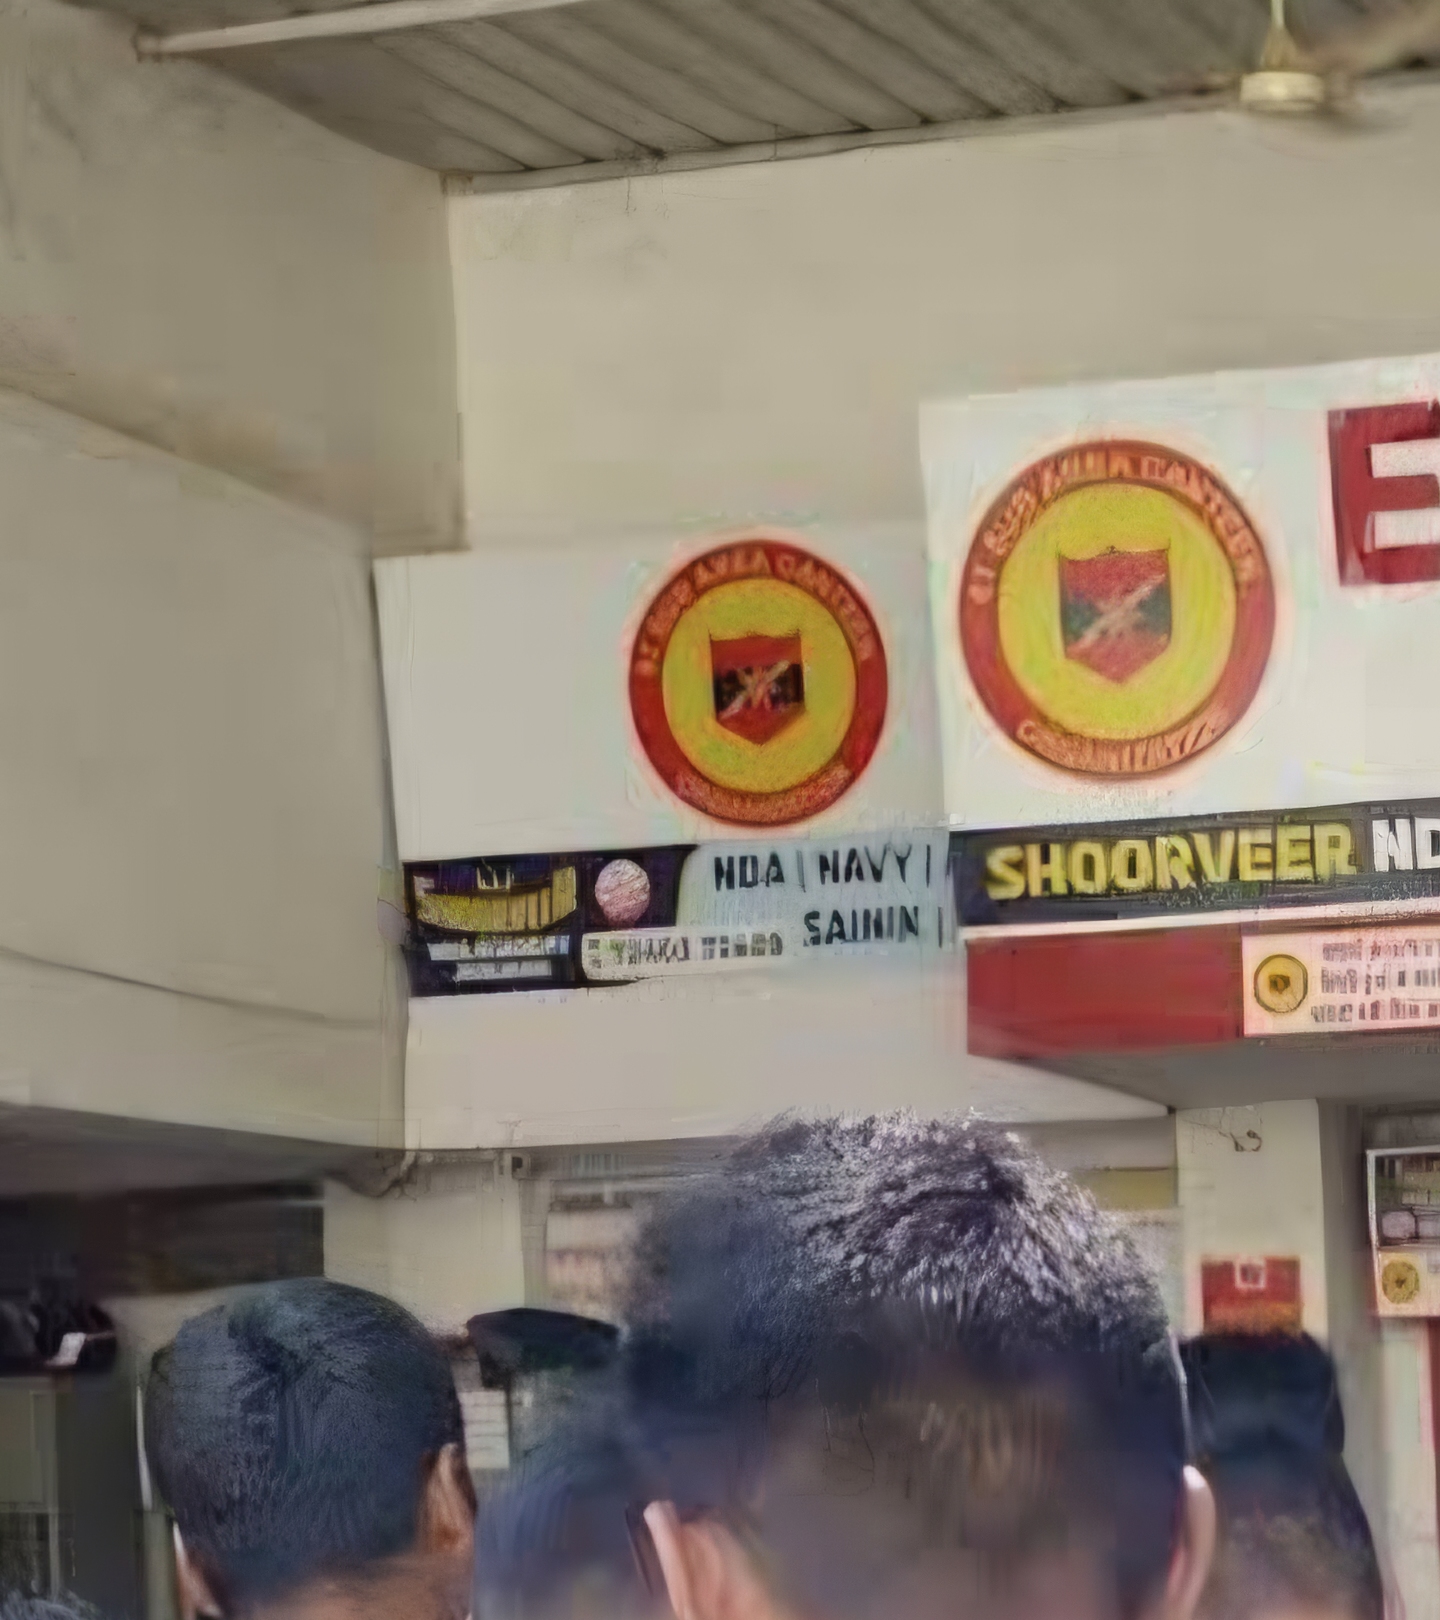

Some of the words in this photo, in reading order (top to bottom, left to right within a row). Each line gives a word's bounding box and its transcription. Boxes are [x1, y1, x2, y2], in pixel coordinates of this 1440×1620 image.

[714, 850, 785, 891] NDA
[820, 842, 912, 884] NAVY
[984, 819, 1357, 900] SHOORVEER
